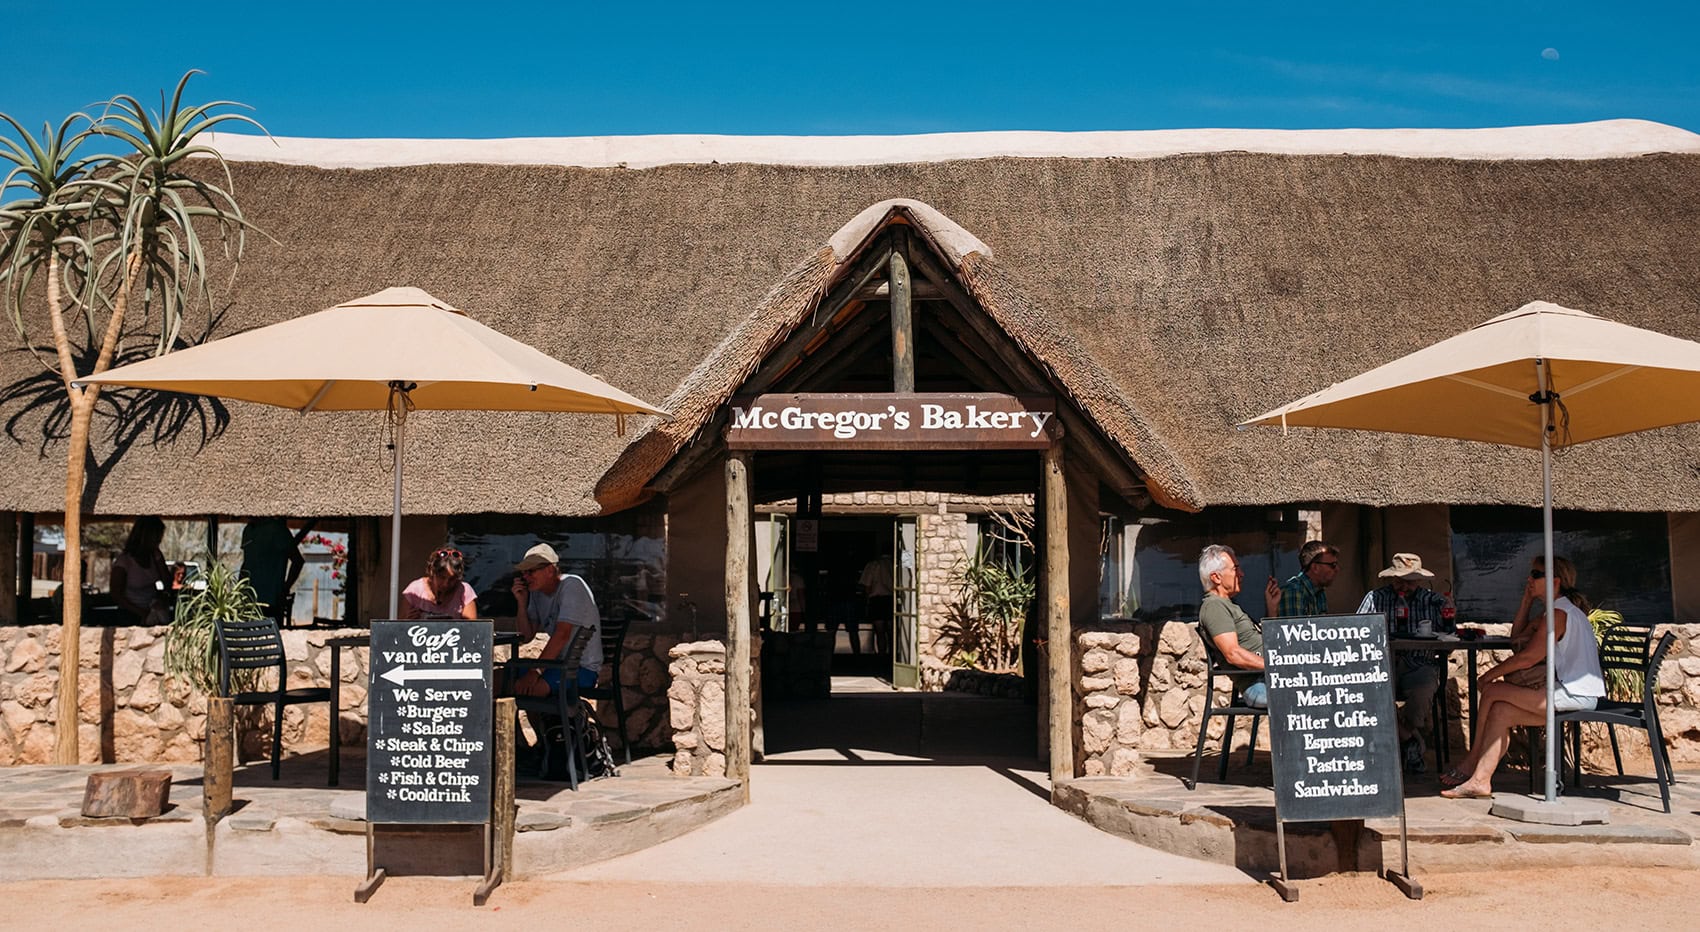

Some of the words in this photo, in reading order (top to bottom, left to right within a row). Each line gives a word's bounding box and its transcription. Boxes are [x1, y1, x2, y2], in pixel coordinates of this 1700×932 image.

[731, 404, 910, 439] McGregor's
[920, 404, 1053, 438] Bakery
[1281, 624, 1370, 642] Welcome
[383, 651, 418, 664] van
[422, 647, 449, 664] der
[451, 647, 482, 664] Lee
[1268, 649, 1321, 666] Famous
[1322, 645, 1359, 667] Apple
[1361, 643, 1383, 661] Pie
[1270, 671, 1309, 689] Fresh
[1311, 666, 1389, 686] Homemade
[392, 688, 420, 702] We
[424, 688, 473, 701] Serve
[1296, 690, 1332, 707] Meat
[1335, 687, 1365, 705] Pies
[406, 704, 468, 722] Burgers
[1287, 713, 1330, 731] Filter
[1334, 710, 1378, 728] Coffee
[412, 721, 464, 735] Salads
[386, 738, 427, 752] Steak
[429, 738, 441, 752] &
[443, 738, 484, 755] Chips
[1303, 733, 1365, 754] Espresso
[401, 755, 433, 769] Cold
[434, 755, 469, 769] Beer
[1306, 755, 1365, 774] Pastries
[391, 771, 423, 786] Fish
[425, 772, 437, 786] &
[438, 771, 480, 789] Chips
[1294, 778, 1379, 798] Sandwiches
[399, 787, 471, 802] Cooldrink
